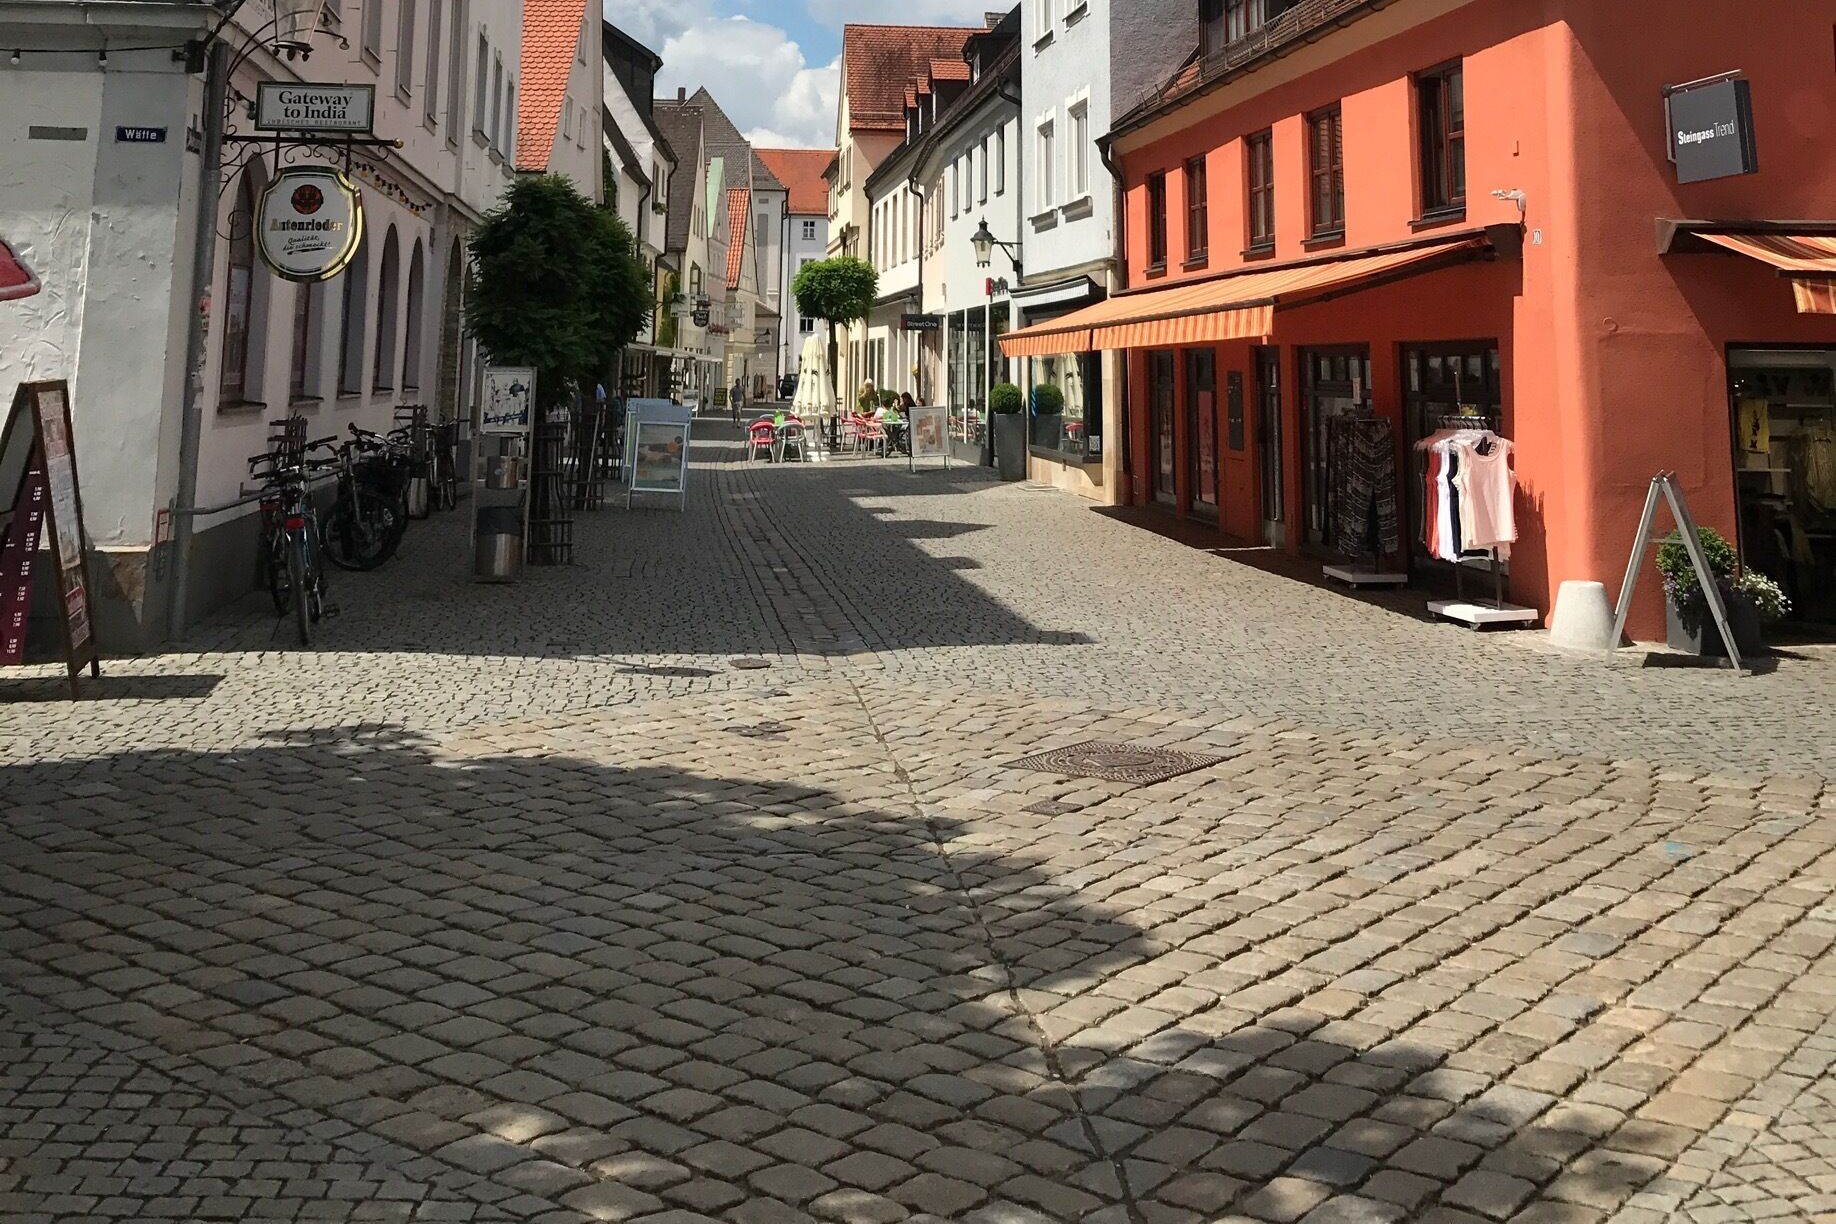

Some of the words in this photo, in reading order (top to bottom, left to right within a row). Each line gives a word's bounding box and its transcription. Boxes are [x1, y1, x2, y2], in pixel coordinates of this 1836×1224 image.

[278, 90, 353, 107] Gateway
[284, 105, 301, 118] to
[304, 105, 346, 119] India
[1677, 128, 1715, 145] Steingass
[1713, 119, 1735, 137] Trend
[925, 320, 938, 328] One
